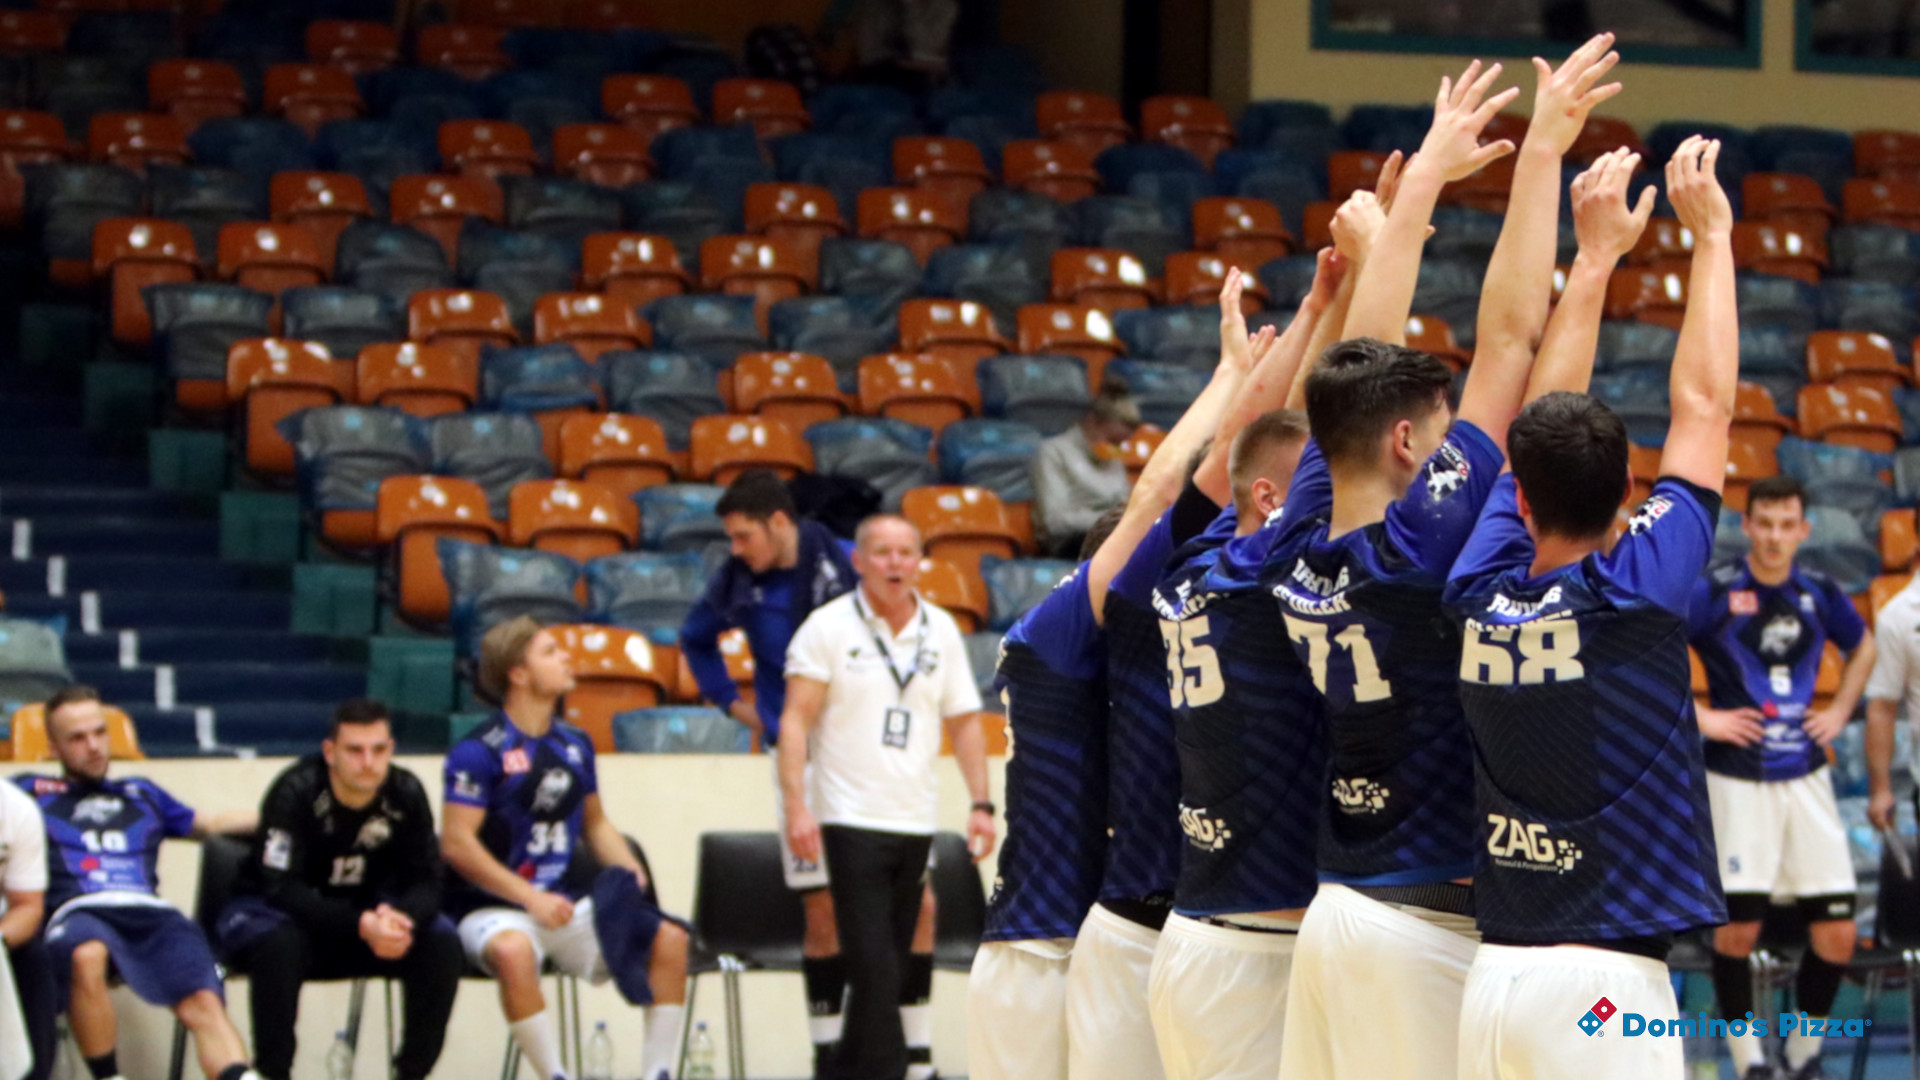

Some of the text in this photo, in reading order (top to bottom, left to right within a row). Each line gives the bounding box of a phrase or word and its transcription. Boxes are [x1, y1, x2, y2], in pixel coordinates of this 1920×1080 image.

[1282, 618, 1392, 703] 71
[1460, 618, 1585, 686] 68
[526, 821, 569, 856] 34
[1487, 813, 1556, 862] ZAG
[328, 854, 367, 887] 12
